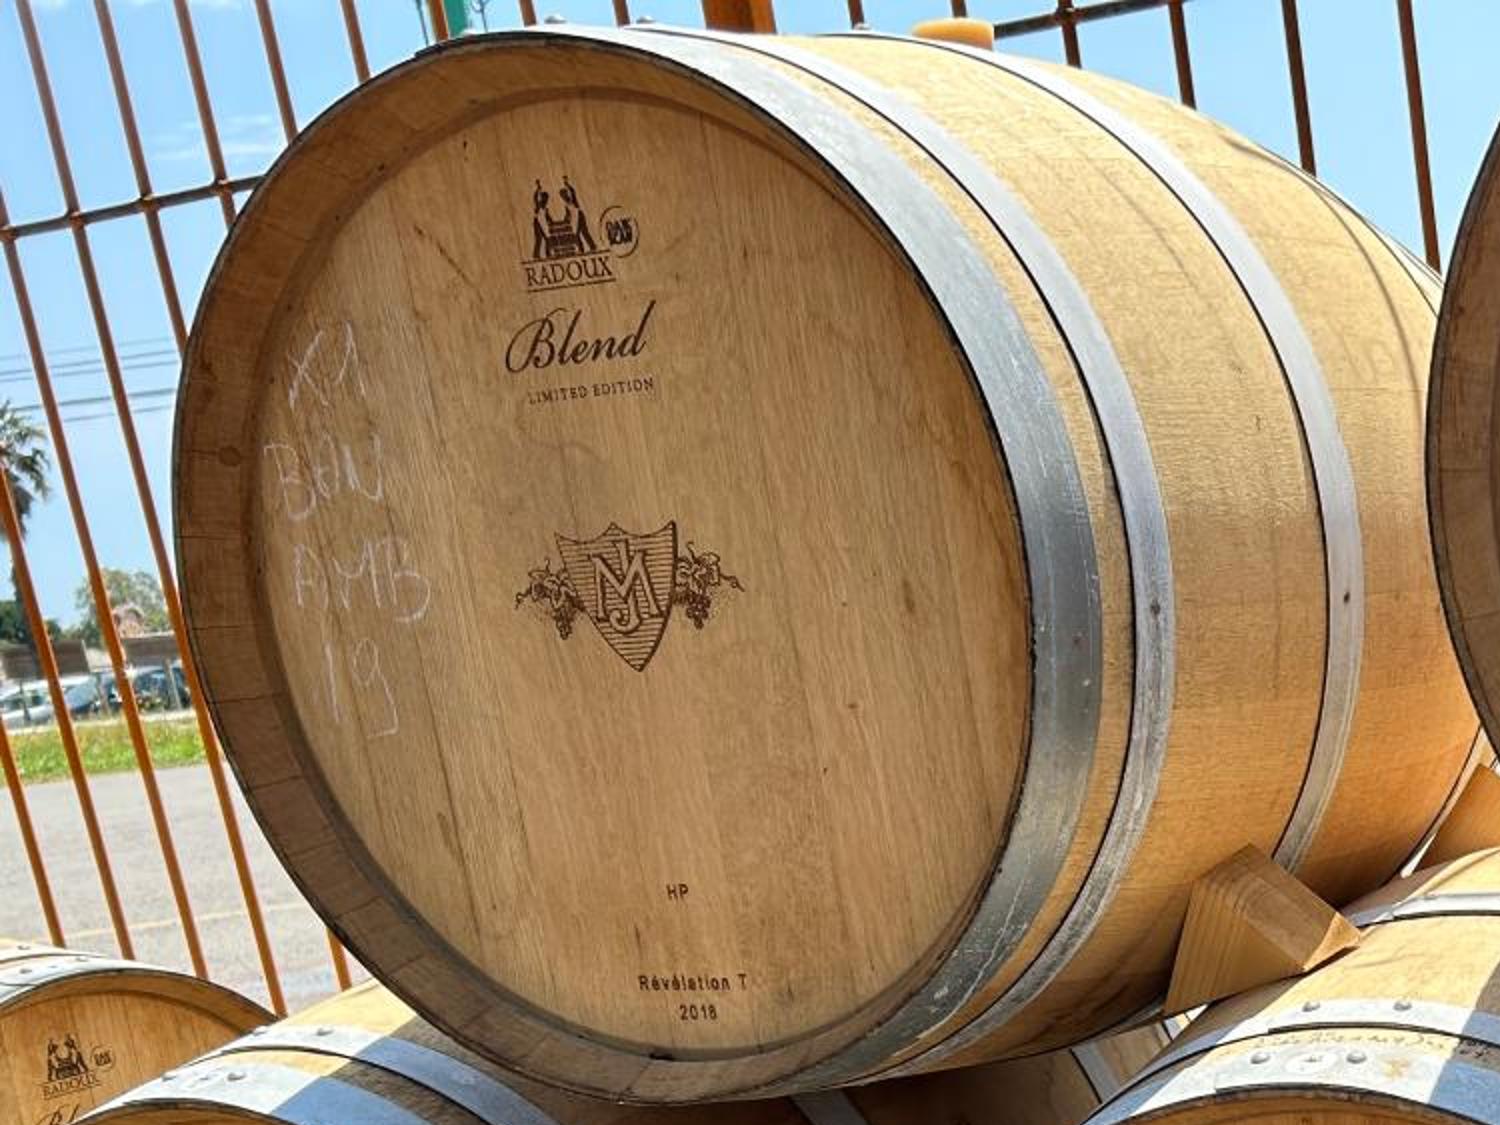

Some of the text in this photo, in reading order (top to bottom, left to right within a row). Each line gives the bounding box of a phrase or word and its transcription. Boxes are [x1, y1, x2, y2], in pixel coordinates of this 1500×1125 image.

[526, 256, 613, 287] RADOUX
[505, 300, 656, 374] Blend
[529, 377, 655, 405] LIMITED EDITION
[666, 883, 689, 901] HP
[637, 973, 748, 991] Révélation T
[679, 1003, 718, 1021] 2018
